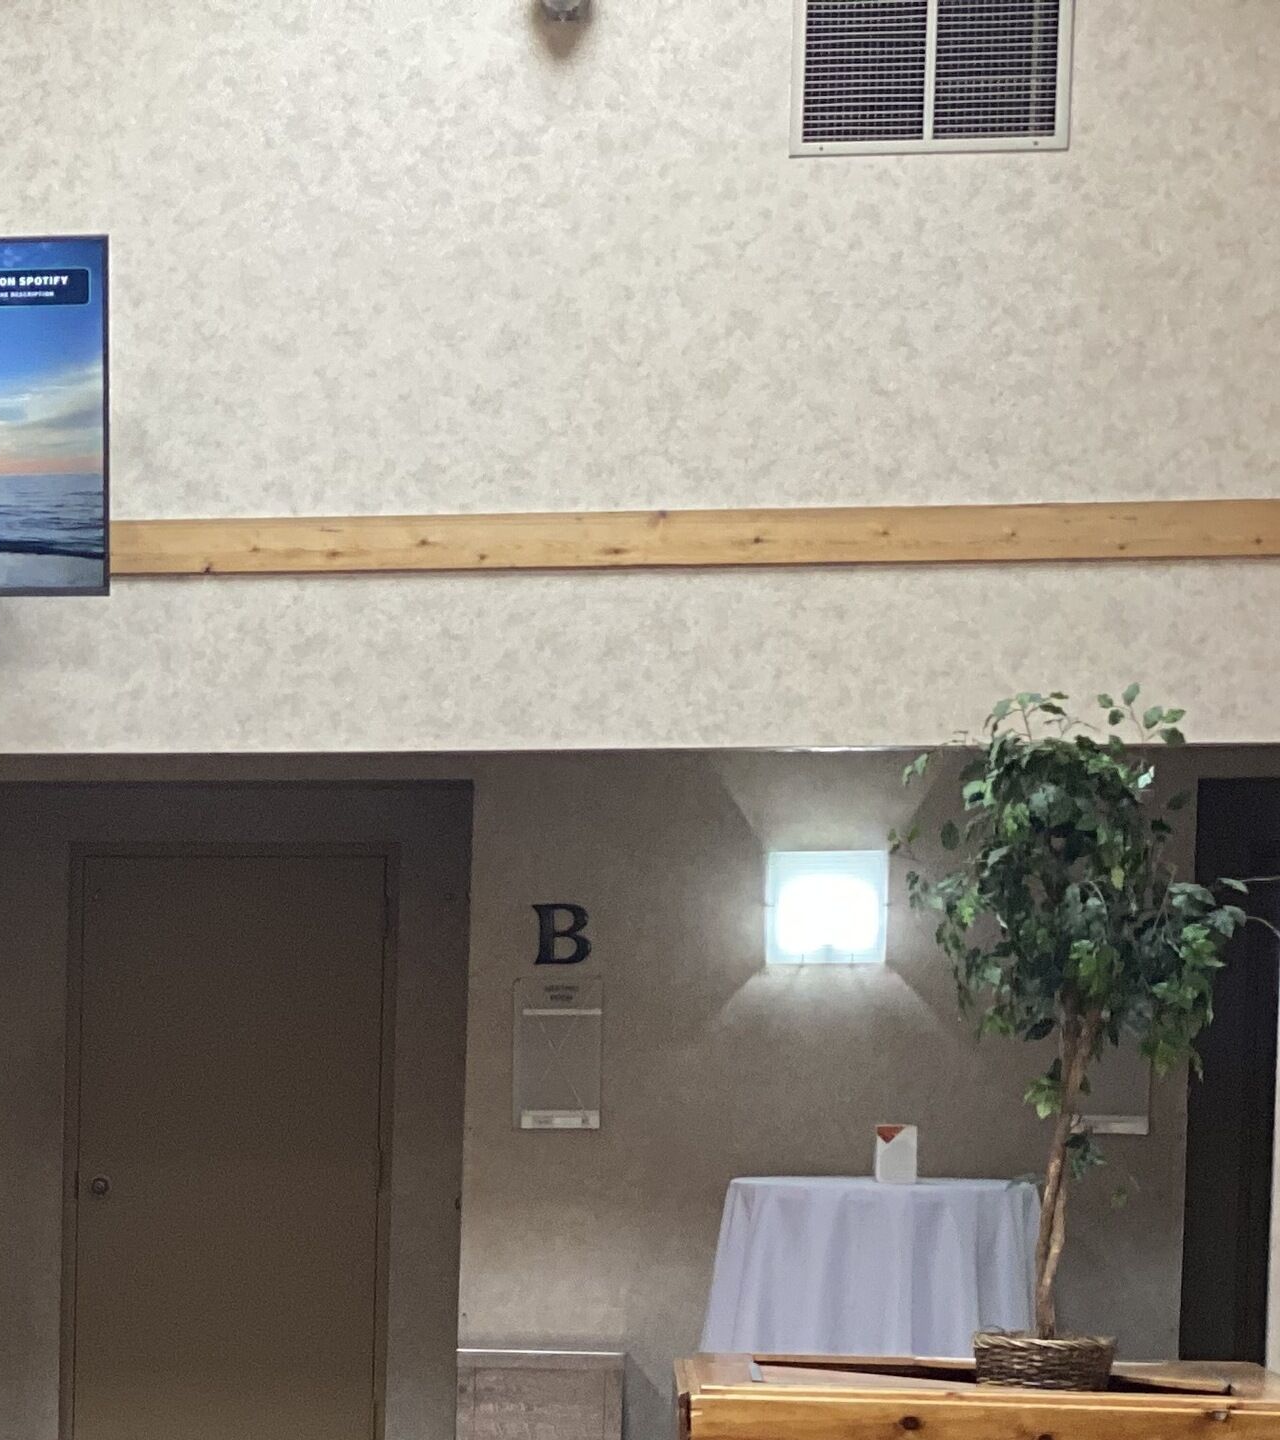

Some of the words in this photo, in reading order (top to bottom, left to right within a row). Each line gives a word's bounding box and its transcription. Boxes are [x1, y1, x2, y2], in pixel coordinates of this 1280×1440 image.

[0, 277, 16, 286] ON
[19, 276, 69, 286] SPOTIFY
[532, 904, 592, 965] B
